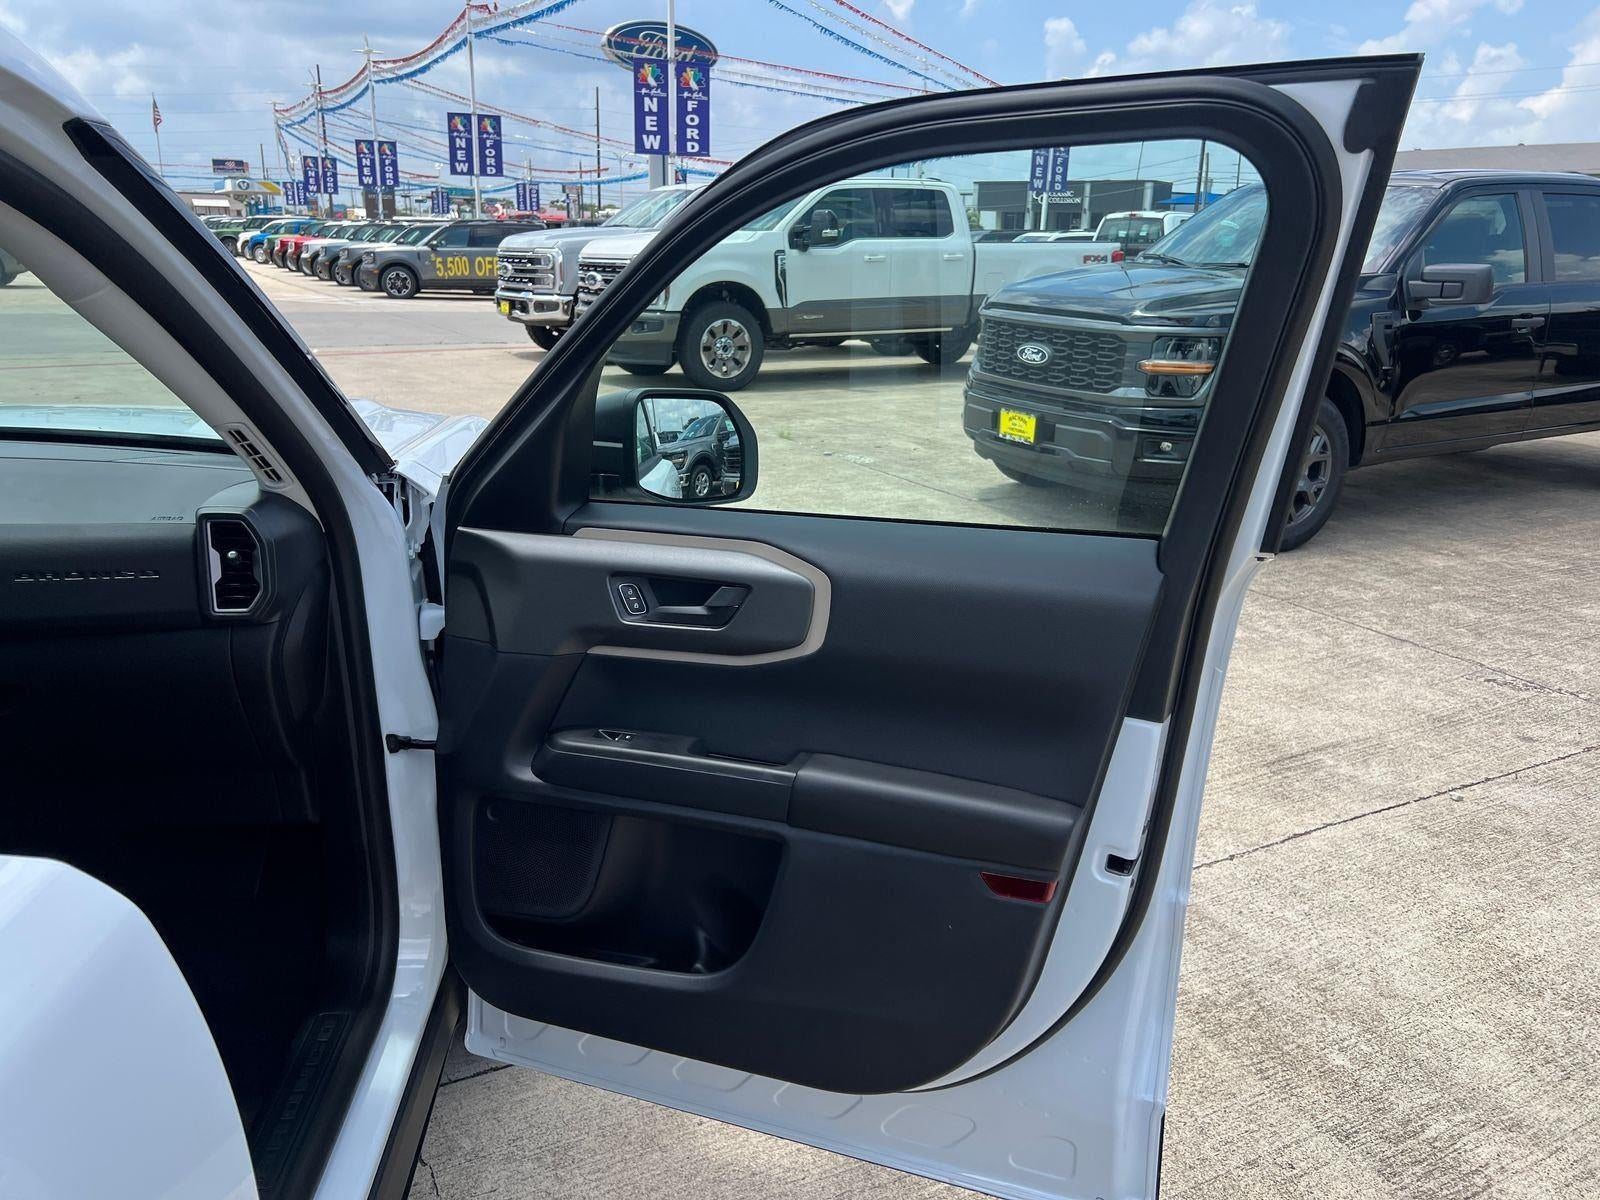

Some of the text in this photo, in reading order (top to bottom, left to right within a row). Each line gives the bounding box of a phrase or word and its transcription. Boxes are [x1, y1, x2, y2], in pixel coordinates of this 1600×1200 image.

[642, 97, 661, 150] NEW
[685, 100, 699, 153] FORD
[362, 158, 373, 184] NEW
[455, 137, 468, 173] NEW
[485, 139, 496, 175] FORD
[1033, 155, 1044, 189] NEW
[308, 171, 317, 191] NEW
[385, 159, 394, 186] FORD
[1055, 157, 1063, 191] FORD
[1022, 347, 1043, 361] Ford
